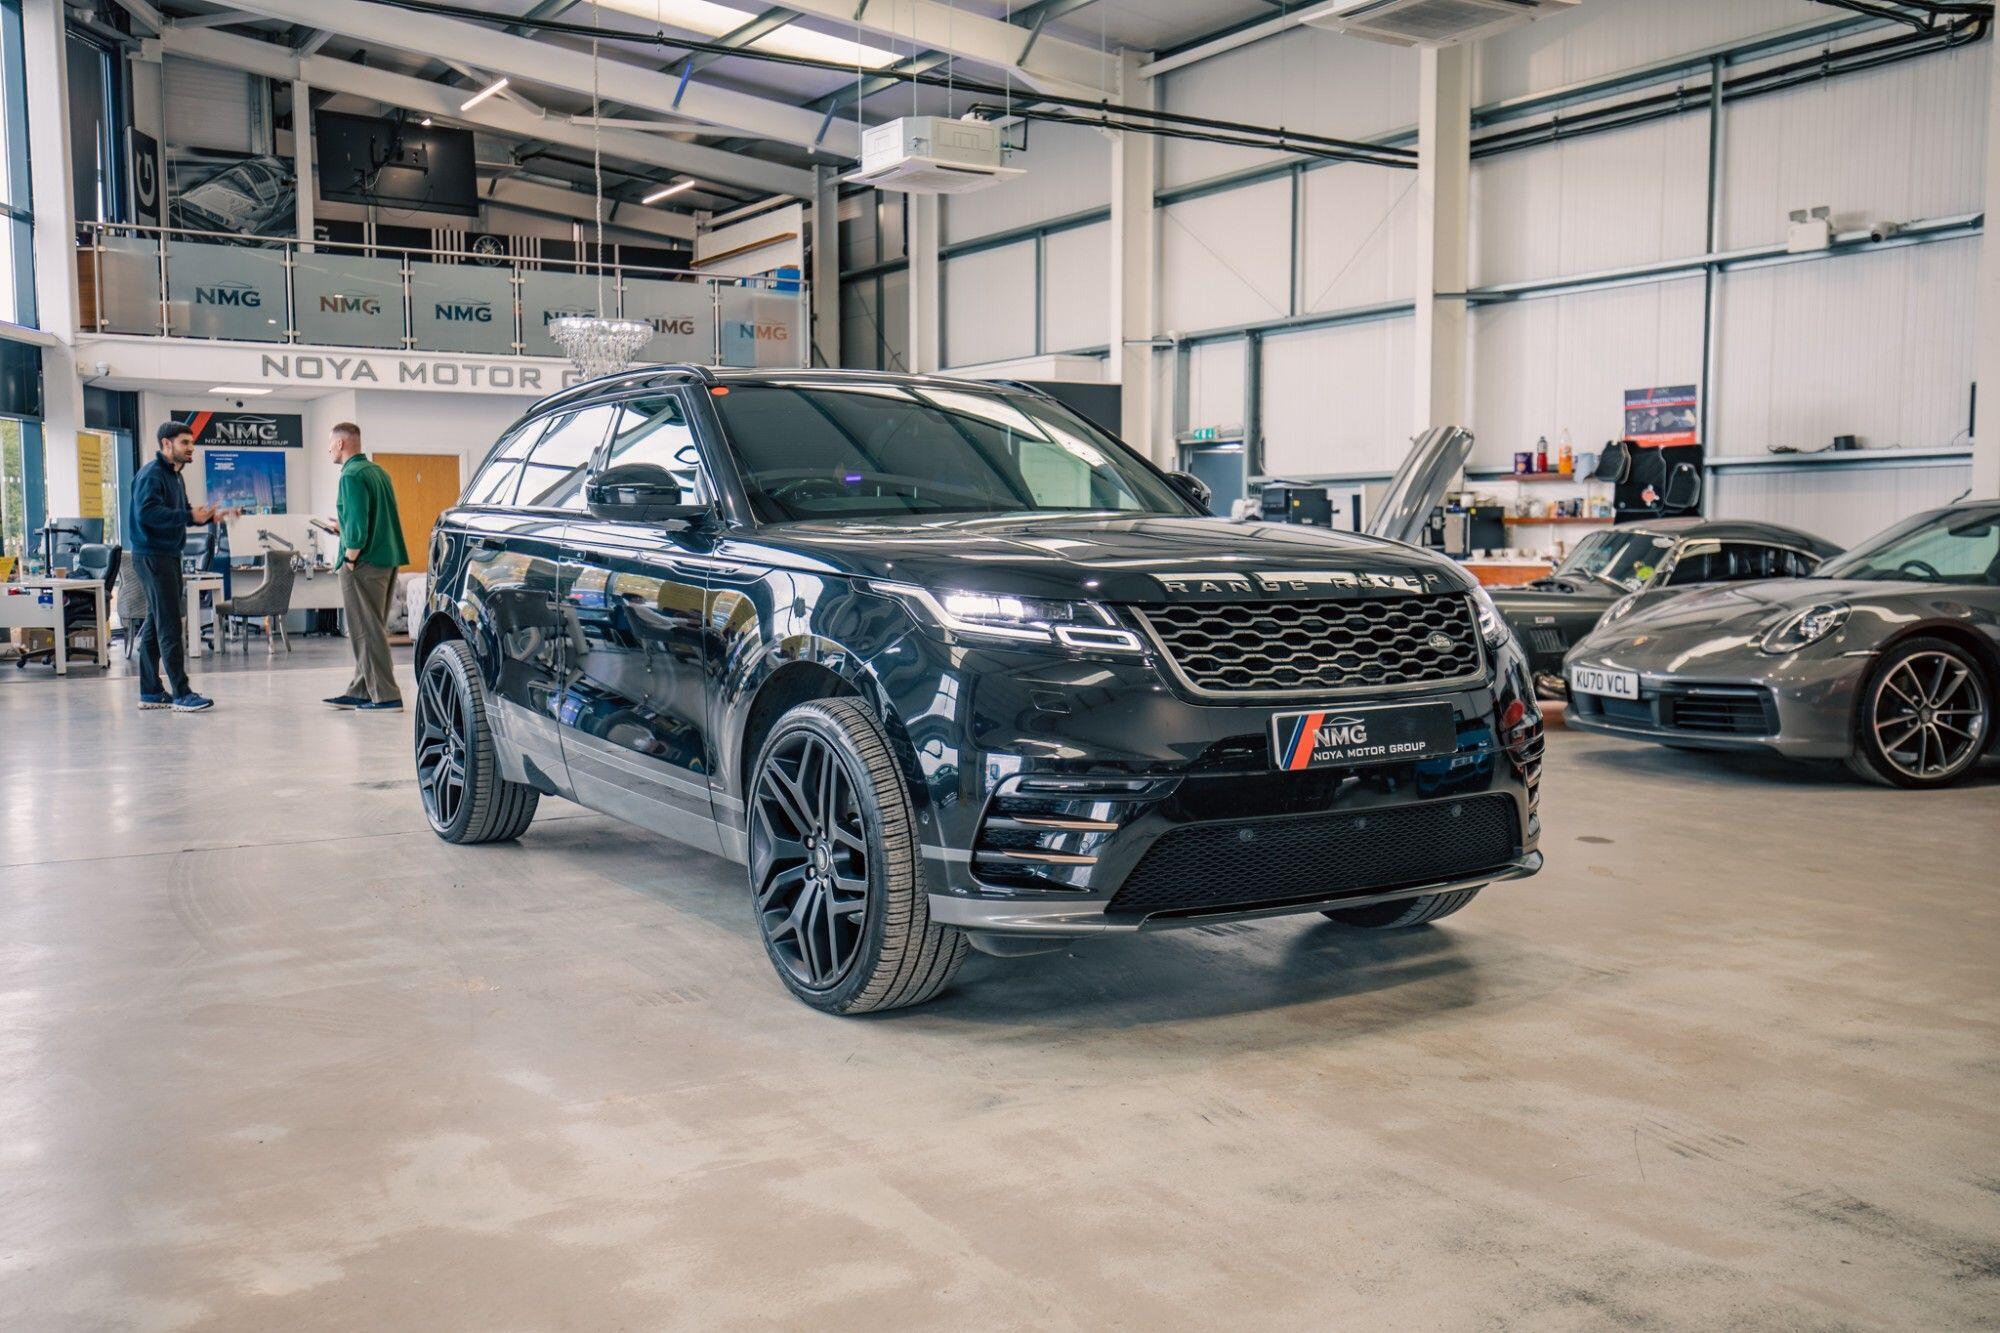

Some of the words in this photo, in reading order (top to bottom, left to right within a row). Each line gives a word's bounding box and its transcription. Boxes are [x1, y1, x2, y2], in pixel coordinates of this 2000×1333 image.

[195, 286, 261, 307] NMG
[319, 296, 381, 315] NMG
[434, 304, 492, 322] NMG
[740, 324, 788, 341] NMG
[262, 354, 378, 382] NOYA
[399, 361, 542, 389] MOTOR
[215, 422, 278, 440] NMG
[1163, 579, 1310, 593] RANGE
[1331, 574, 1441, 590] ROVER
[1576, 670, 1603, 690] KU70
[1607, 674, 1631, 694] VCL
[1312, 725, 1367, 748] NMG
[1313, 750, 1344, 761] NOYA
[1347, 745, 1386, 758] MOTOR
[1389, 741, 1426, 753] GROUP
